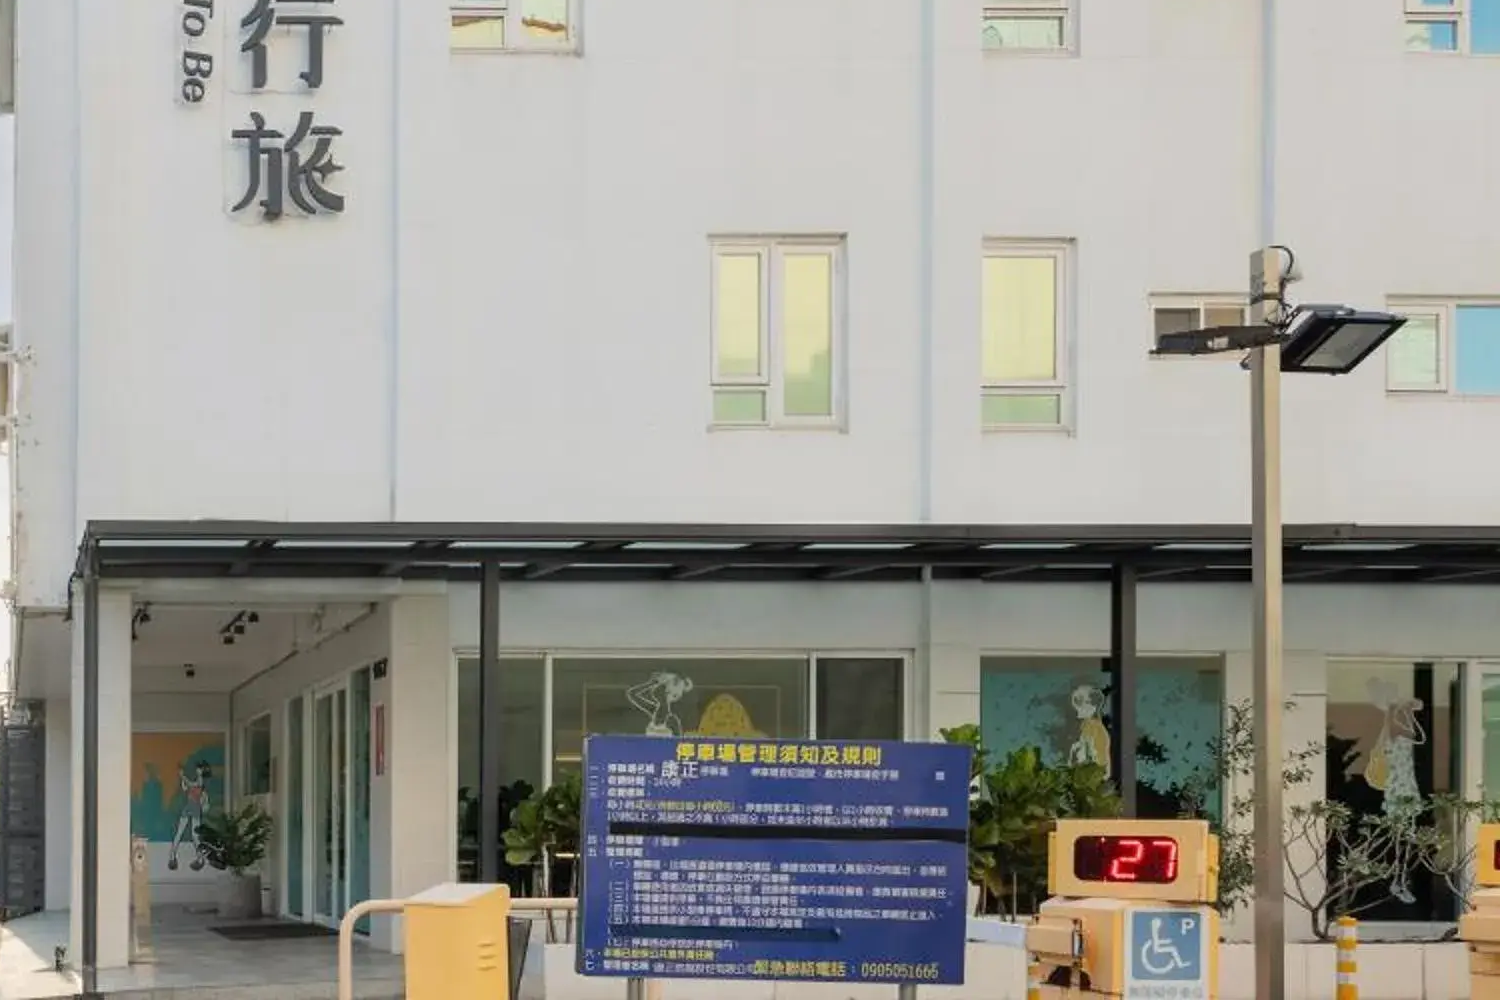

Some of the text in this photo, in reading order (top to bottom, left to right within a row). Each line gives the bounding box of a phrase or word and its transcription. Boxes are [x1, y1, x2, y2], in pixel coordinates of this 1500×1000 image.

[182, 51, 214, 104] Be
[676, 743, 882, 766] 停車場管理須知及規則
[1111, 840, 1178, 879] 27
[1181, 918, 1196, 936] P
